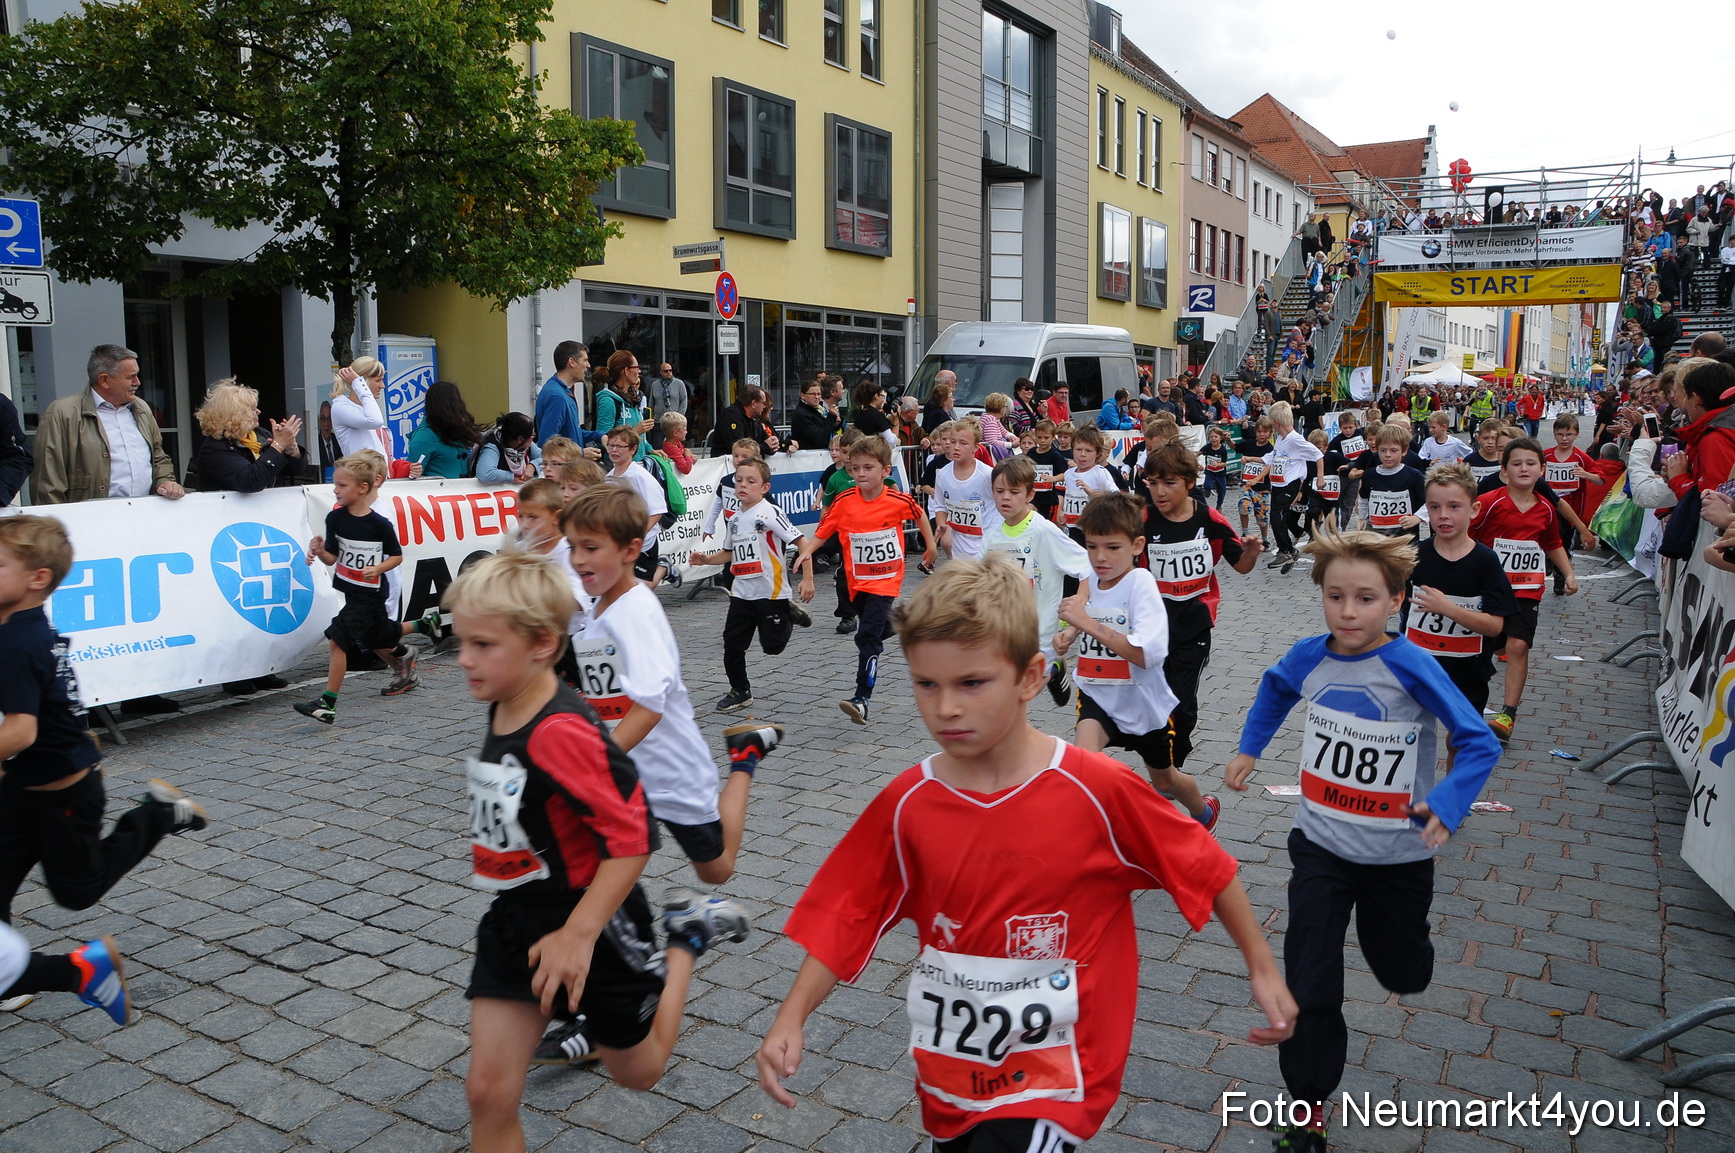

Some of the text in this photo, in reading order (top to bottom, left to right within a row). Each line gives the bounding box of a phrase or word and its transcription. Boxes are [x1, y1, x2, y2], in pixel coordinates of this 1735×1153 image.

[674, 244, 719, 257] Brunnwirtsgasse
[1477, 237, 1574, 252] EfficientDynamics
[1450, 275, 1535, 296] START
[1344, 441, 1366, 454] 7165
[675, 509, 704, 524] erzen
[948, 509, 978, 526] 7372
[1373, 501, 1407, 516] 7323
[658, 523, 702, 543] der Stadt
[855, 541, 896, 563] 7259
[1150, 545, 1201, 557] PARTL Neumarkt
[1495, 543, 1515, 551] PARTL
[333, 548, 379, 570] 7264
[1156, 553, 1206, 579] 7103
[1500, 550, 1541, 571] 7096
[869, 565, 887, 575] Nico
[1308, 712, 1401, 745] PARTL Neumarkt
[1312, 731, 1406, 788] 7087
[1322, 784, 1377, 813] Moritz
[1026, 917, 1051, 928] TSV
[954, 972, 1041, 993] Neumarkt
